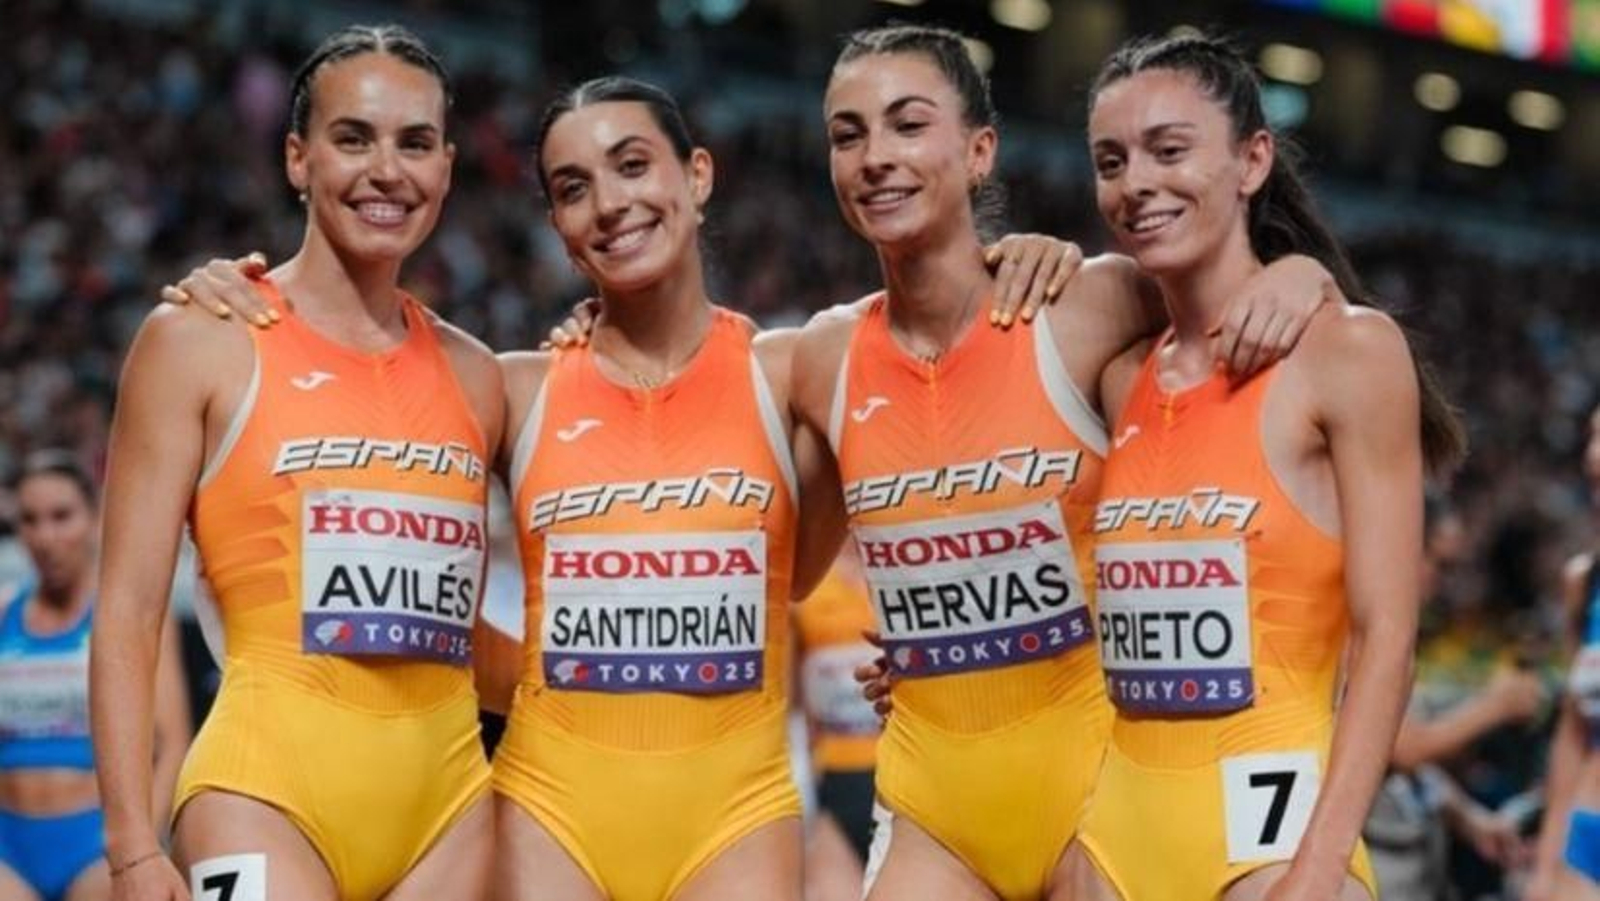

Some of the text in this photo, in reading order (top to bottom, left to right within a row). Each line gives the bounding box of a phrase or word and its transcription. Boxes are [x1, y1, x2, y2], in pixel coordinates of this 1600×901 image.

[309, 503, 483, 550] HONDA
[529, 468, 775, 534] ESPAÑA
[1094, 487, 1261, 533] SPAÑA
[549, 548, 761, 580] HONDA
[863, 520, 1063, 569] HONDA
[318, 563, 474, 621] AVILÉS
[879, 563, 1071, 634] HERVAS
[550, 593, 757, 648] SANTIDRIÁN
[1099, 609, 1233, 661] PRIETO
[1248, 770, 1298, 846] 7
[202, 870, 241, 901] 7
